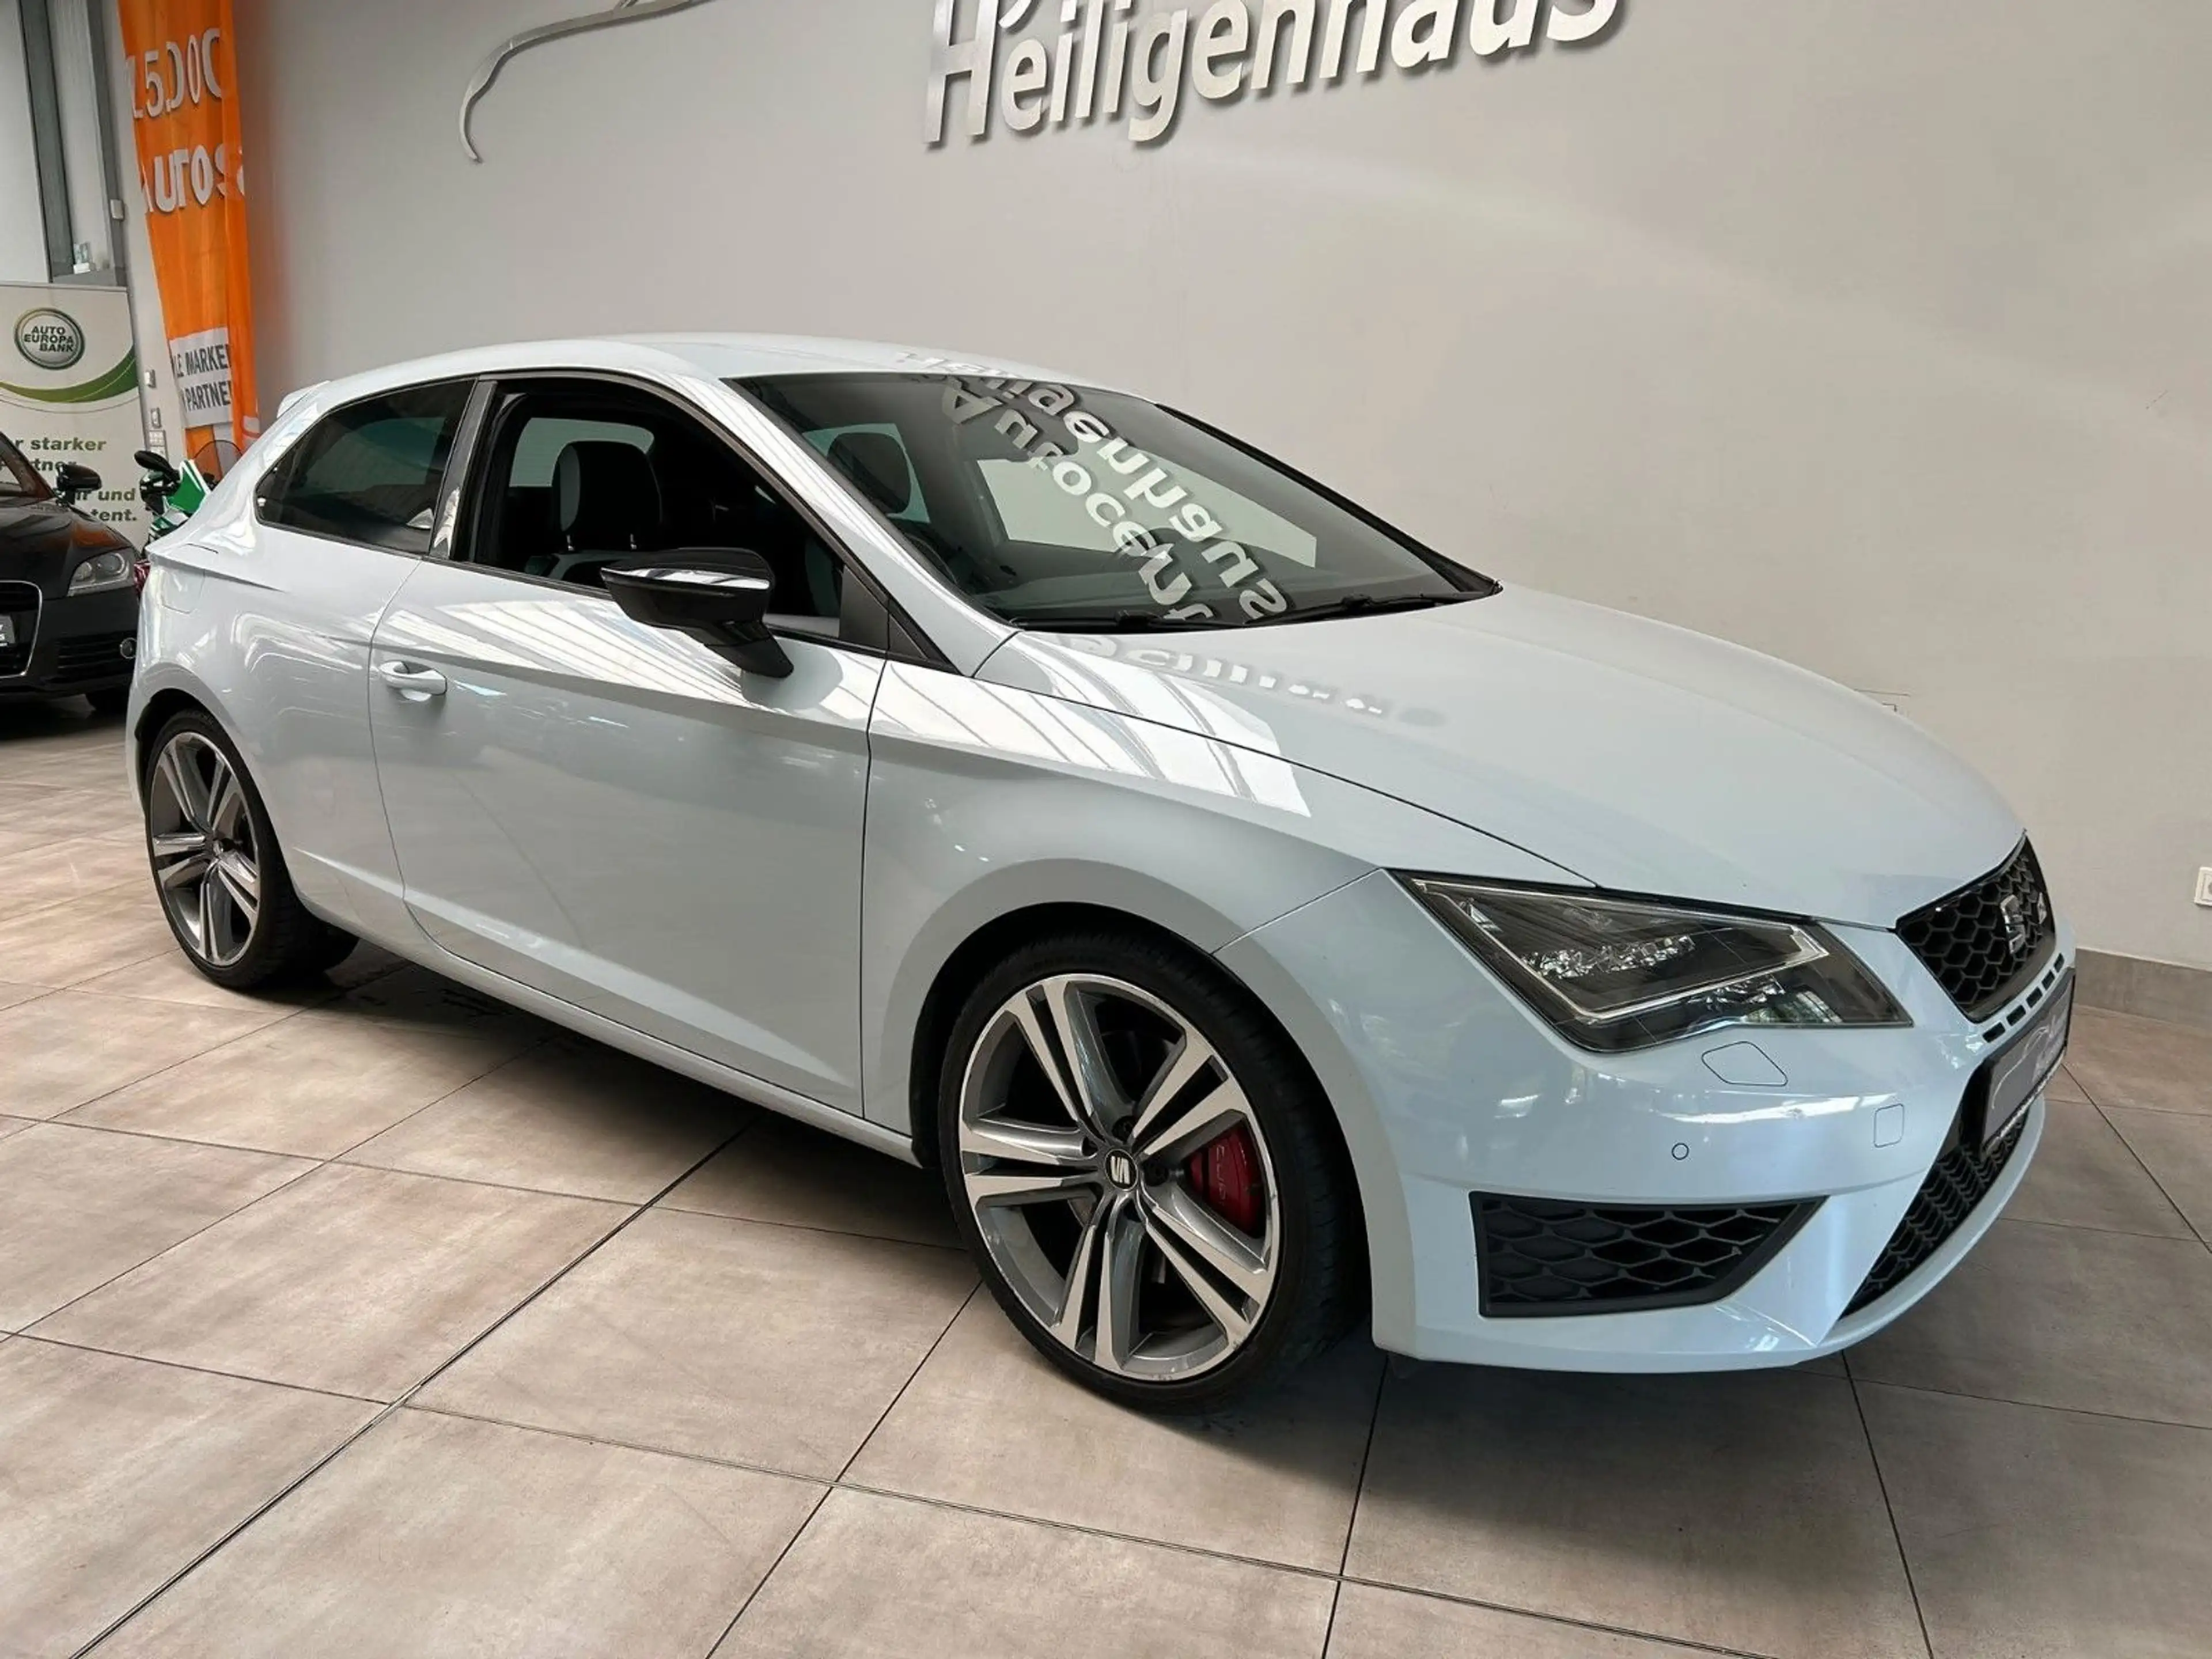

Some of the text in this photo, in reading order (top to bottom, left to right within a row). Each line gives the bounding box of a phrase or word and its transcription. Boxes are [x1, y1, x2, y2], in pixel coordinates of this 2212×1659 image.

[31, 326, 65, 335] AUTO
[24, 334, 73, 344] EUROPA
[39, 343, 74, 352] BANK
[185, 343, 231, 376] MARKE
[185, 380, 231, 411] PARTNE
[31, 437, 107, 451] starker
[98, 488, 136, 501] und
